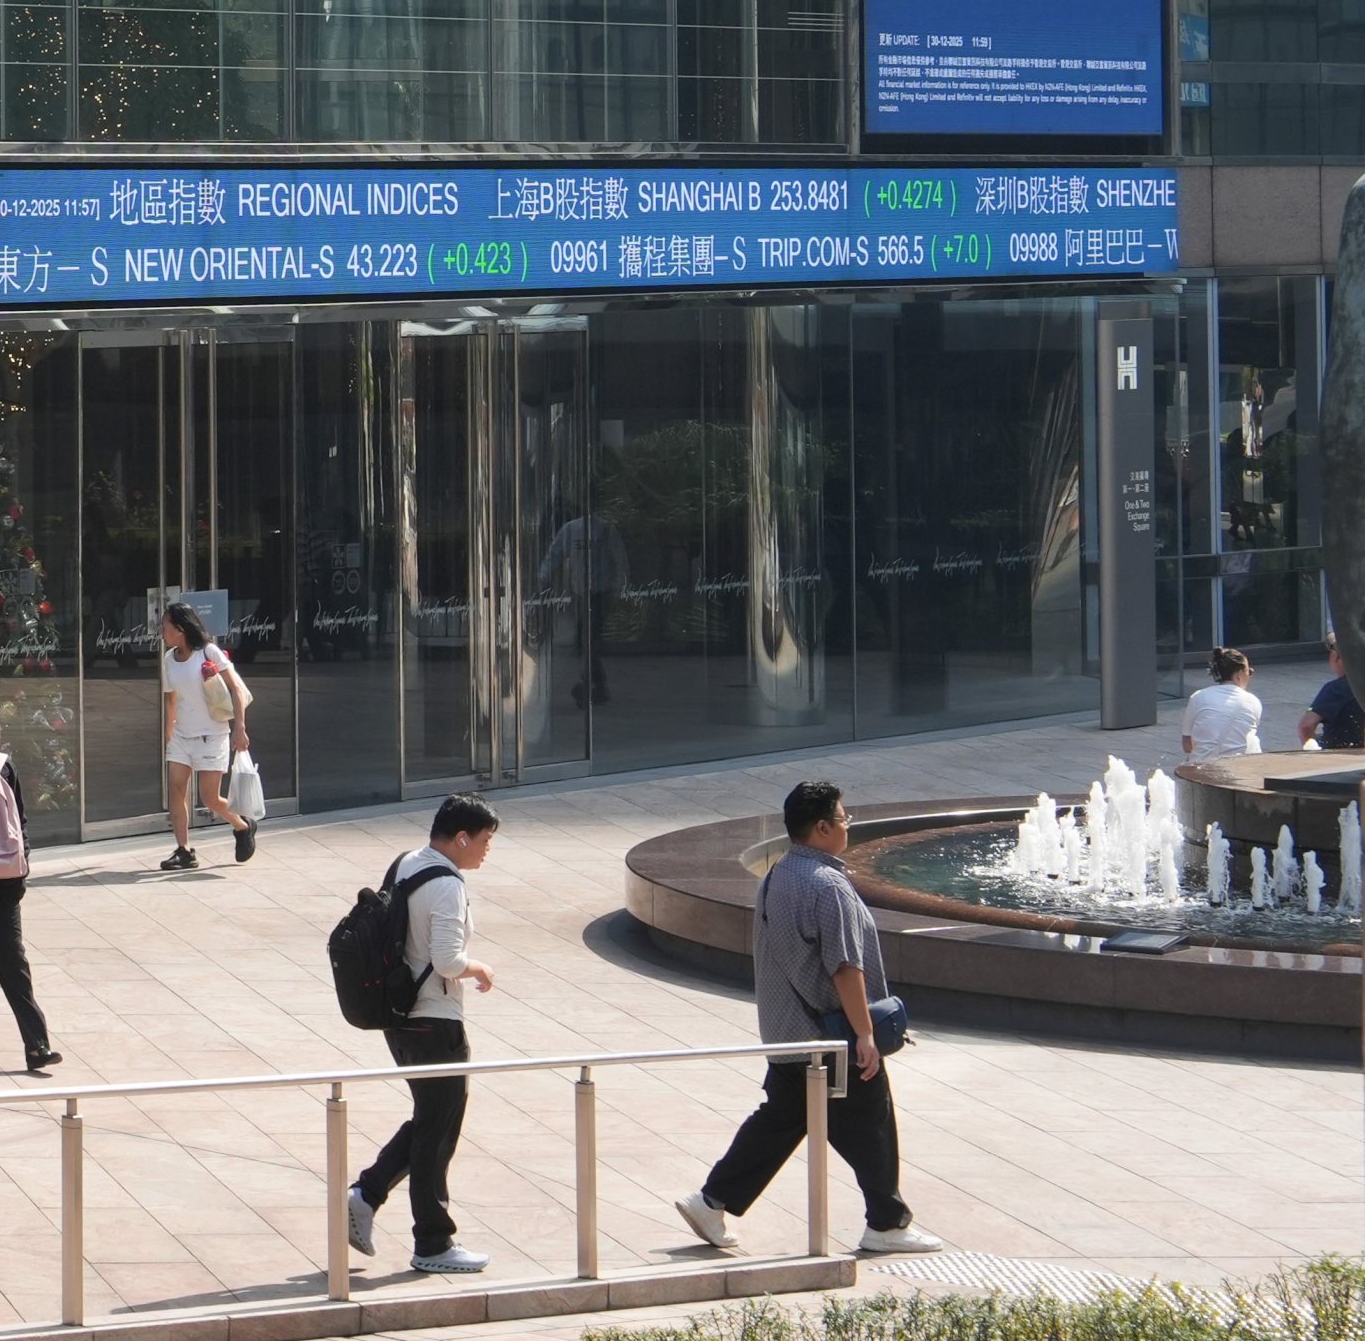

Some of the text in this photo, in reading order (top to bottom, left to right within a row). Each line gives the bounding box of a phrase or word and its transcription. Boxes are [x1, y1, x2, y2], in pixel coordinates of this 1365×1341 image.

[65, 199, 99, 220] 11:57]
[110, 179, 225, 225] 地區指數
[239, 183, 360, 216] REGIONAL
[368, 182, 458, 215] INDICES
[489, 177, 628, 221] 上海B股指數
[639, 181, 742, 212] SHANGHAI
[749, 182, 760, 210] B
[771, 181, 847, 211] 253.8481
[976, 176, 1089, 215] 深圳B股指數
[126, 249, 183, 282] NEW
[190, 245, 334, 281] ORIENTAL-S
[347, 244, 417, 277] 43.223
[551, 240, 606, 273] 09961
[758, 236, 868, 267] TRIP.COM-S
[878, 235, 923, 265] 566.5
[1010, 233, 1057, 261] 09988
[1125, 500, 1135, 510] One
[1140, 500, 1150, 509] Two
[1127, 511, 1150, 522] Exchange
[1133, 522, 1150, 532] Square
